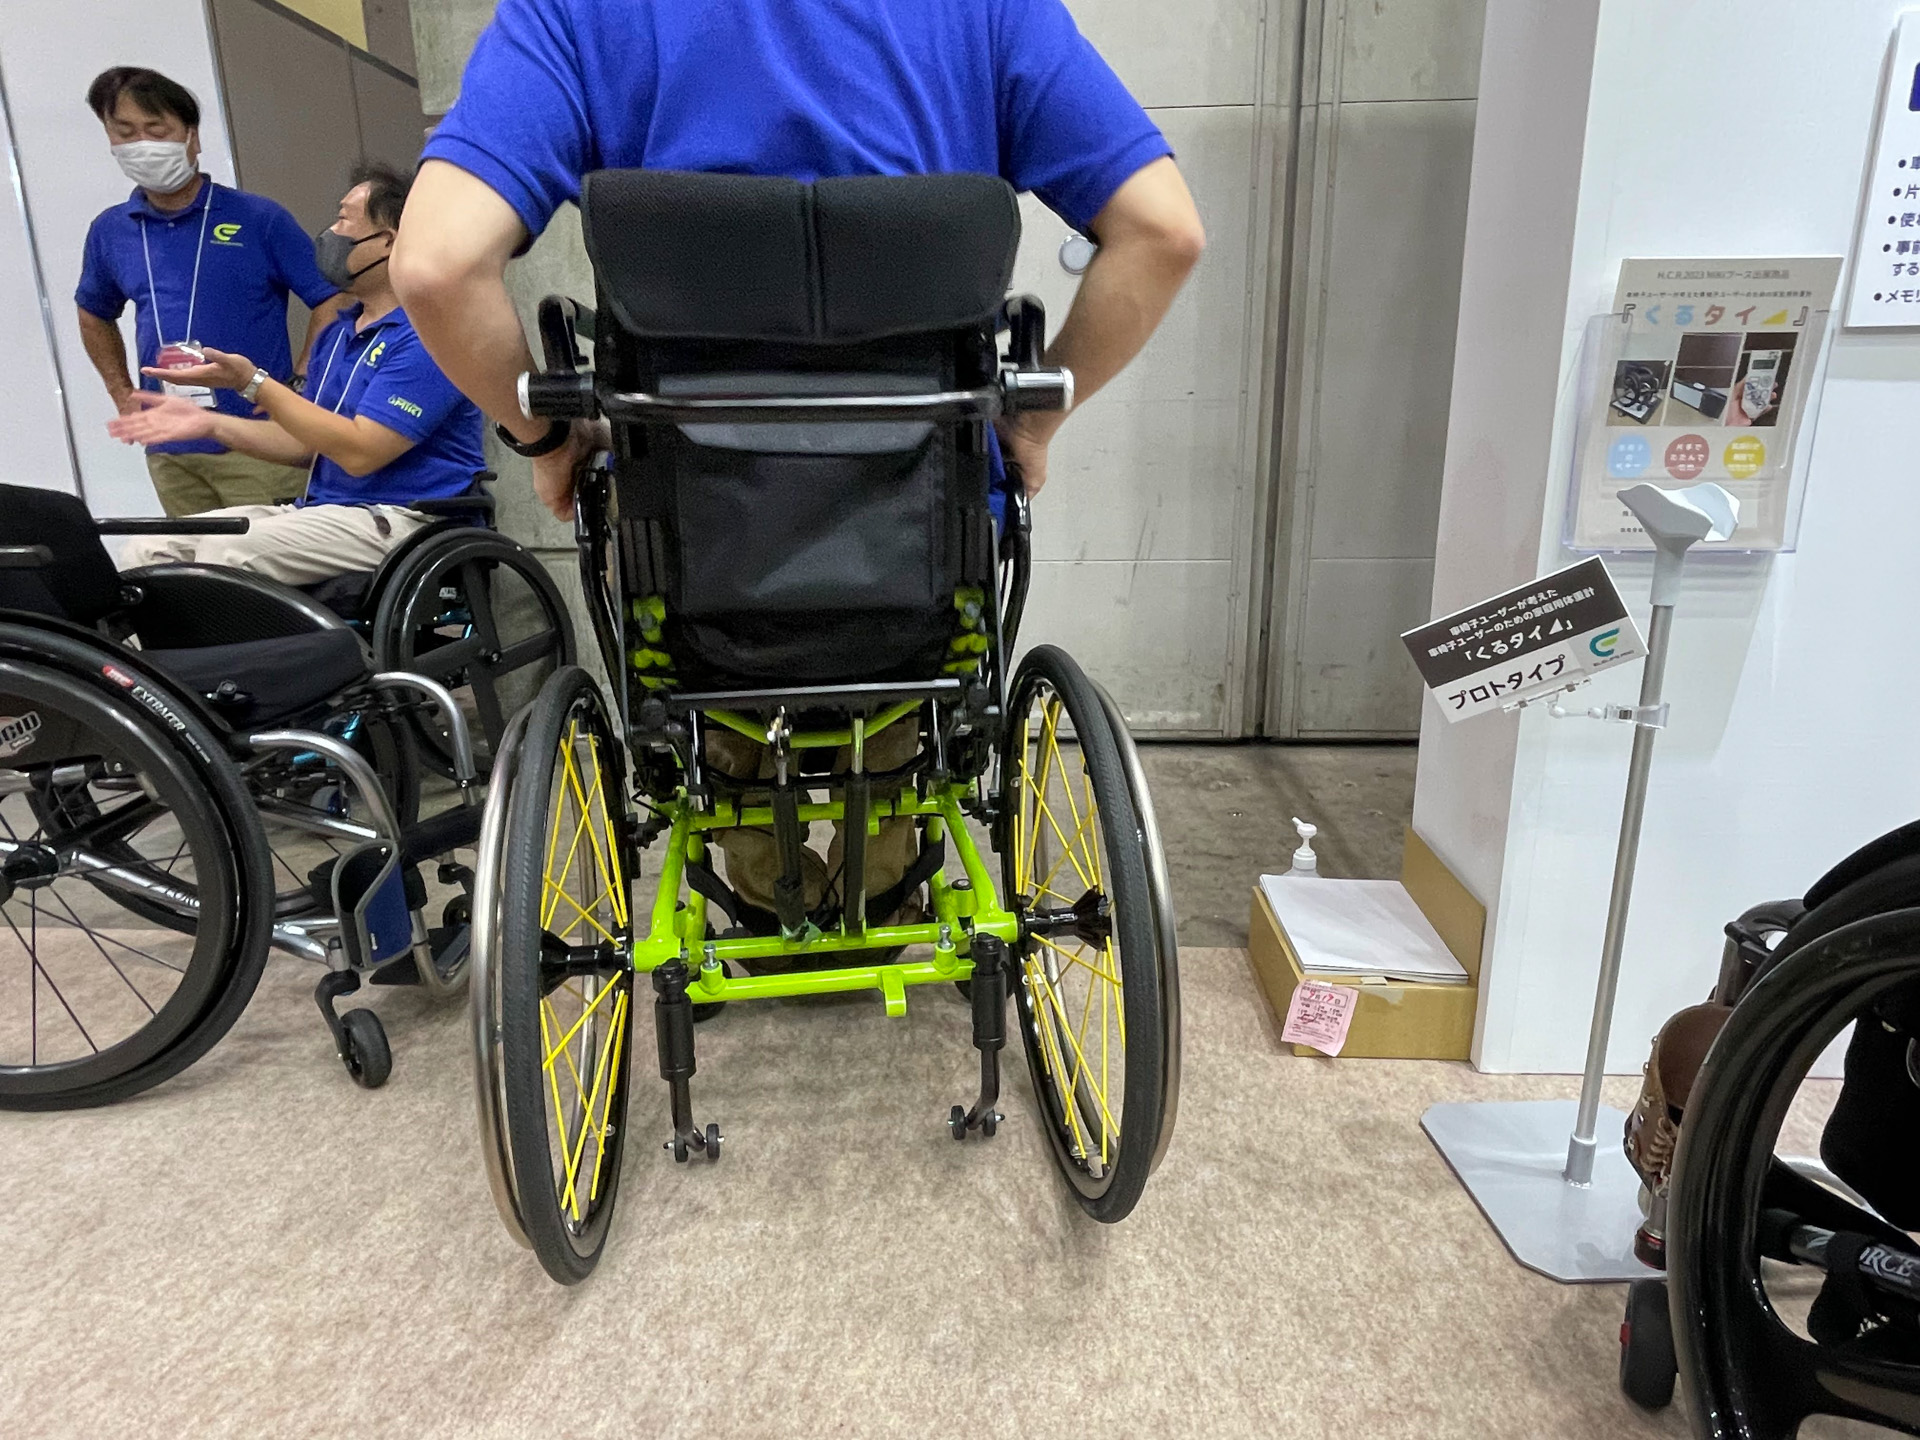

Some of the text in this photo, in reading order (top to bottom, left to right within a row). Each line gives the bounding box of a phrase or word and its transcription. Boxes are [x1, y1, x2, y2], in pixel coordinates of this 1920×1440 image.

[1892, 263, 1920, 276] する
[1448, 653, 1567, 710] プロトタイプ
